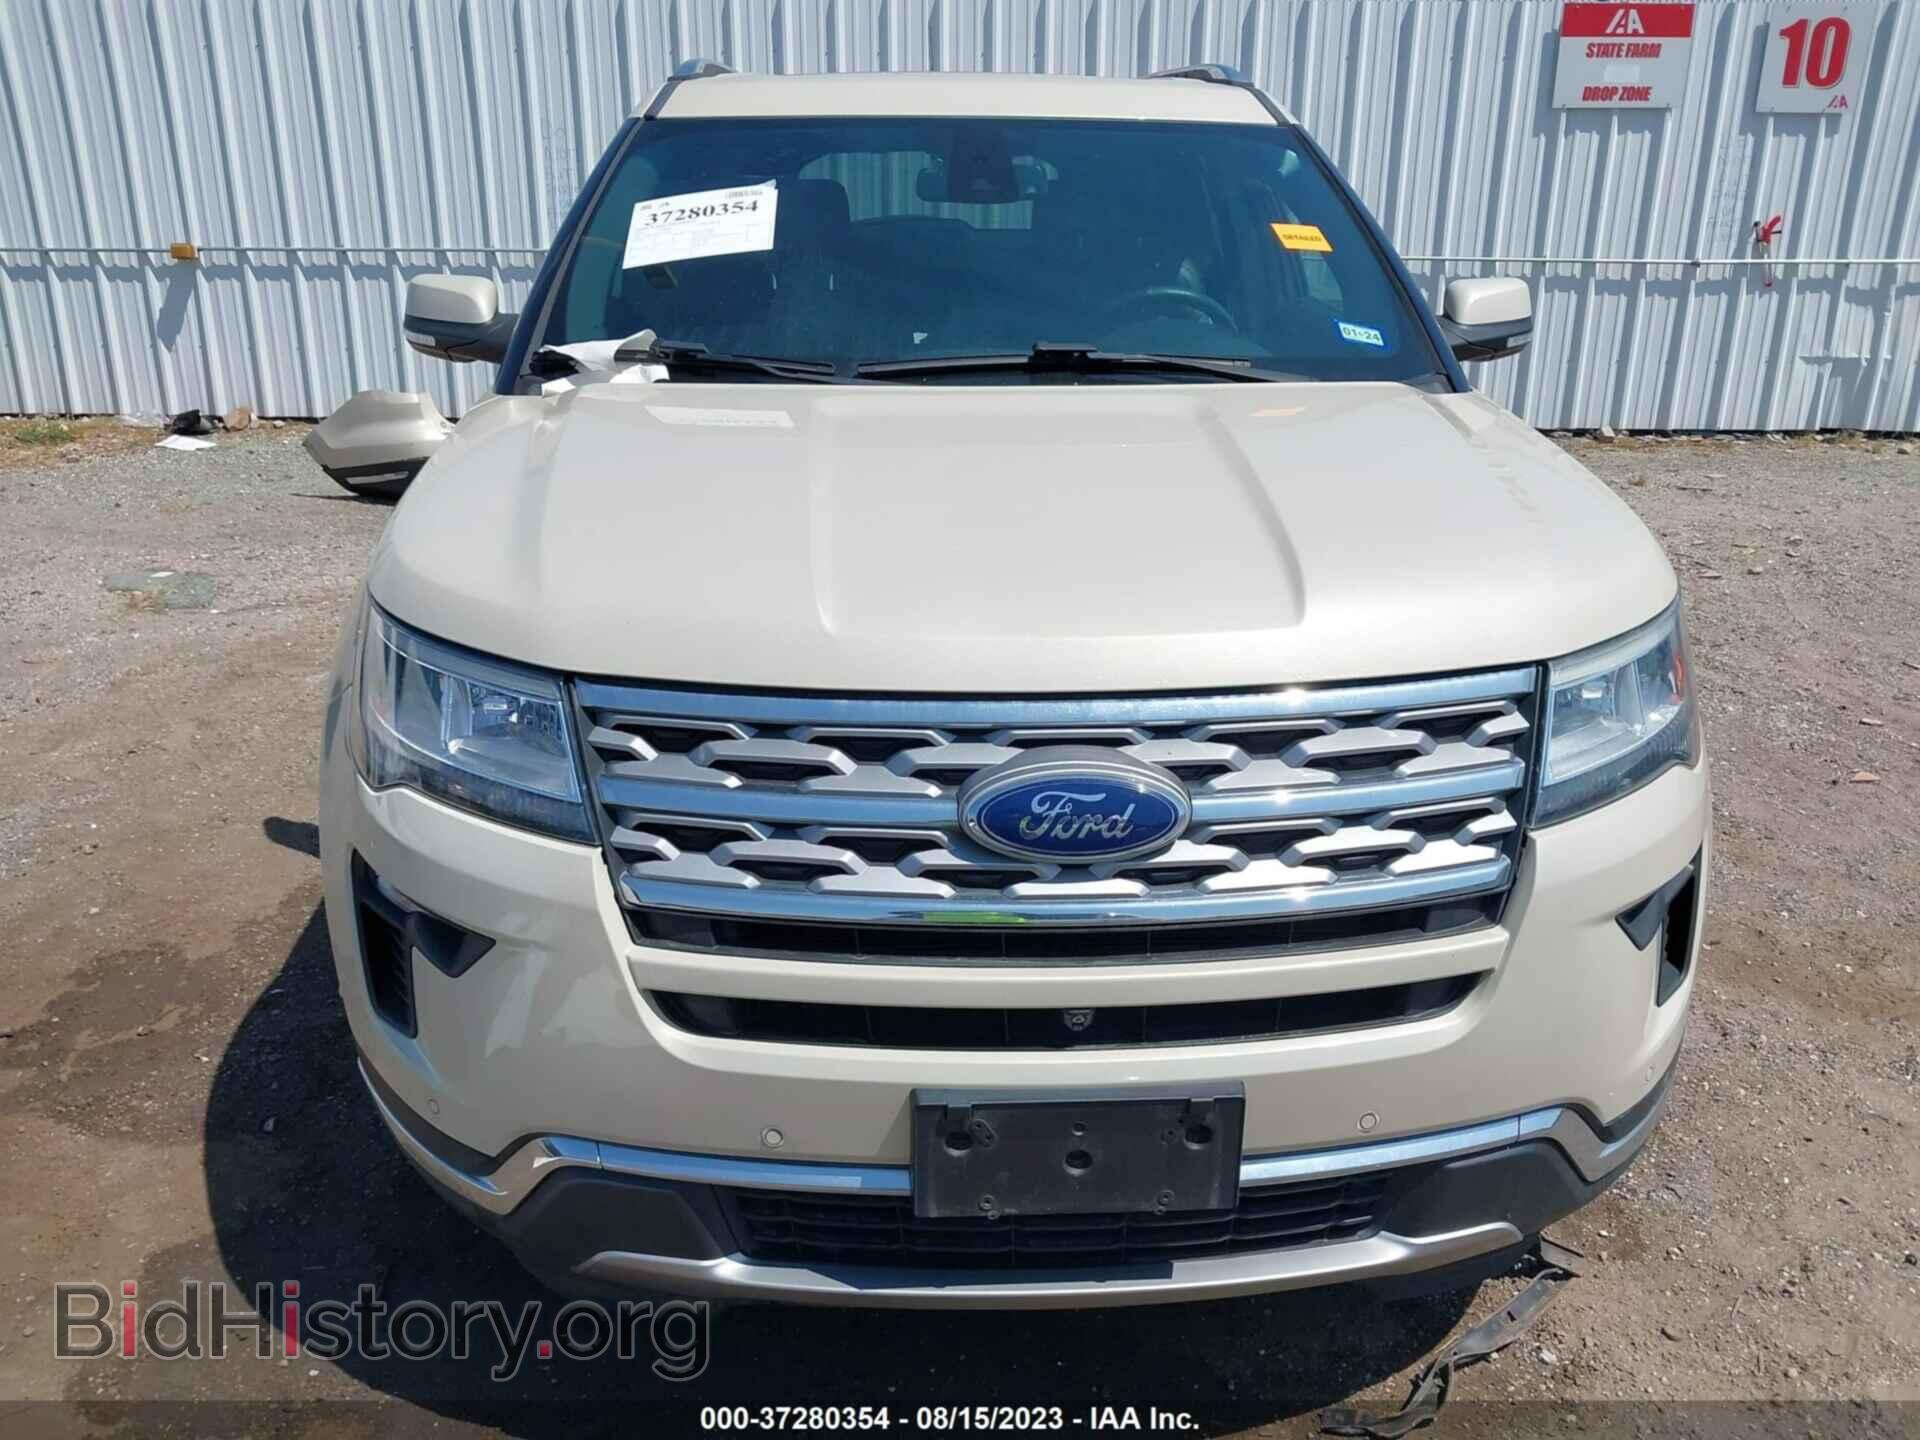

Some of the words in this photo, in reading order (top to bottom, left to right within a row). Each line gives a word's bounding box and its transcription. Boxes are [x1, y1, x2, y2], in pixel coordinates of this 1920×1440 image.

[1585, 42, 1625, 58] STATE
[1626, 42, 1662, 58] FARM
[1779, 16, 1851, 89] 10
[1582, 86, 1618, 101] DROP
[1620, 86, 1652, 101] ZONE
[644, 199, 759, 226] 37280354
[1019, 791, 1136, 839] Ford
